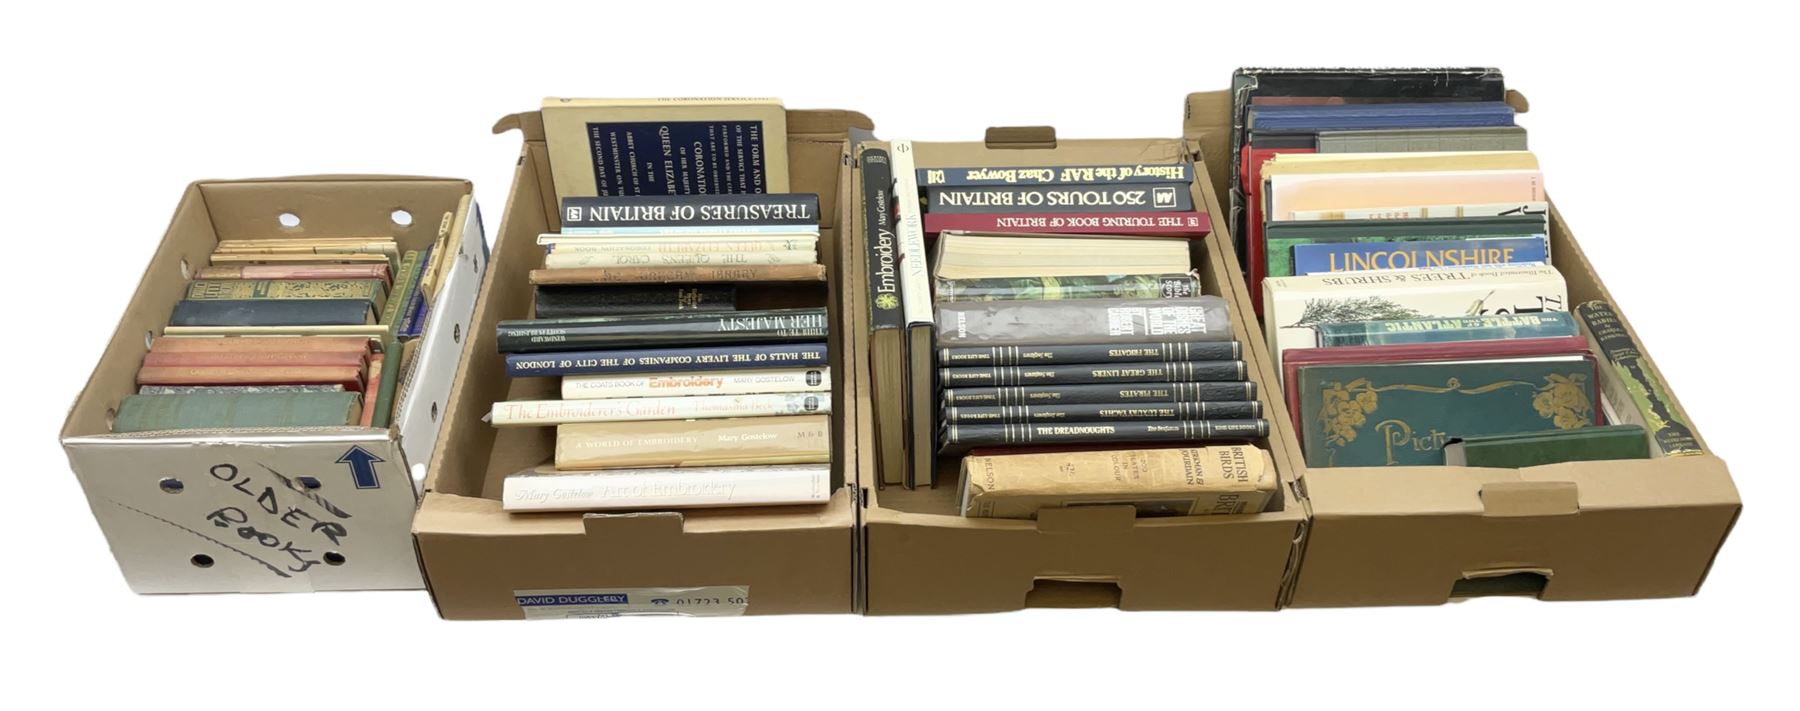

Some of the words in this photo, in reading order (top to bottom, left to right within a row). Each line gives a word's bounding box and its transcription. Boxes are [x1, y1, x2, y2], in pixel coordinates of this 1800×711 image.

[735, 125, 741, 133] OF
[658, 126, 672, 156] QUEEN
[594, 140, 604, 165] SECOND
[679, 147, 686, 155] OF
[711, 153, 717, 161] TO
[751, 144, 760, 166] FORM
[610, 131, 620, 173] WESTMINSTER
[616, 175, 622, 185] ON
[629, 152, 637, 176] CHURCH
[598, 166, 606, 178] DAY
[693, 142, 706, 195] CORONATIO
[1060, 168, 1094, 180] RAF
[1096, 168, 1117, 180] the
[1118, 168, 1130, 180] of
[1134, 166, 1184, 180] History
[967, 170, 1016, 182] Bowyer
[1018, 170, 1055, 182] Chaz
[681, 171, 690, 195] MAJESTY
[939, 192, 1013, 206] BRITAIN
[1018, 192, 1043, 206] OF
[1048, 191, 1111, 206] TOURS
[1113, 191, 1146, 205] 250
[589, 206, 666, 222] BRITAIN
[670, 206, 694, 220] OF
[702, 204, 810, 220] TREASURES
[878, 212, 886, 226] Mary
[997, 218, 1046, 227] BRITAIN
[1050, 218, 1064, 227] OF
[1067, 218, 1099, 226] BOOK
[1103, 217, 1156, 226] TOURING
[1159, 217, 1183, 226] THE
[612, 254, 650, 265] CAROL
[874, 229, 896, 292] Embroidery
[1329, 248, 1514, 272] LINCOLNSHIRE
[1322, 274, 1392, 286] SHRUBS
[1392, 274, 1406, 284] &
[1410, 272, 1470, 283] TREES
[1134, 308, 1144, 316] BY
[1163, 307, 1174, 316] OF
[718, 316, 786, 332] MAJESTY
[788, 314, 823, 328] HER
[958, 312, 967, 338] NELSON
[1120, 308, 1134, 335] ROBERT
[1149, 308, 1163, 335] WORLD
[1176, 306, 1190, 333] DISHES
[1189, 306, 1206, 334] GREAT
[1386, 319, 1462, 332] ATLANTIC
[1482, 315, 1542, 327] BATTLE
[791, 328, 823, 336] TRIBUTE
[1164, 320, 1177, 334] THE
[695, 355, 729, 363] LIVERY
[733, 354, 751, 362] THE
[1109, 349, 1142, 357] FRIGATES
[516, 361, 556, 370] LONDON
[559, 360, 572, 368] OF
[575, 359, 598, 367] CITY
[600, 358, 620, 366] THE
[623, 358, 636, 366] OF
[640, 356, 692, 365] COMPANIES
[616, 380, 634, 388] BOOK
[636, 380, 644, 388] OF
[649, 376, 723, 389] Embroidery
[753, 375, 795, 384] GOSTELOW
[1120, 390, 1151, 398] PIRATES
[504, 403, 530, 420] The
[626, 404, 676, 417] Garden
[1037, 427, 1053, 435] THE
[1055, 426, 1115, 434] DREADNOUGHTS
[585, 439, 620, 448] WORLD
[622, 439, 634, 447] OF
[637, 436, 698, 446] EMBROIDERY
[718, 434, 739, 442] Mary
[740, 432, 778, 441] Gostelow
[1122, 462, 1129, 470] IN
[1219, 450, 1234, 480] BIRDS
[1231, 447, 1248, 483] BRITISH
[984, 458, 995, 490] NELSON
[515, 489, 549, 502] Mary
[553, 488, 594, 500] Gostelow
[600, 484, 626, 496] Art
[628, 480, 647, 496] of
[652, 480, 738, 500] Embroidery
[210, 464, 347, 546] OLDER
[518, 596, 554, 605] DAVID
[559, 594, 625, 604] DUGGLEBY
